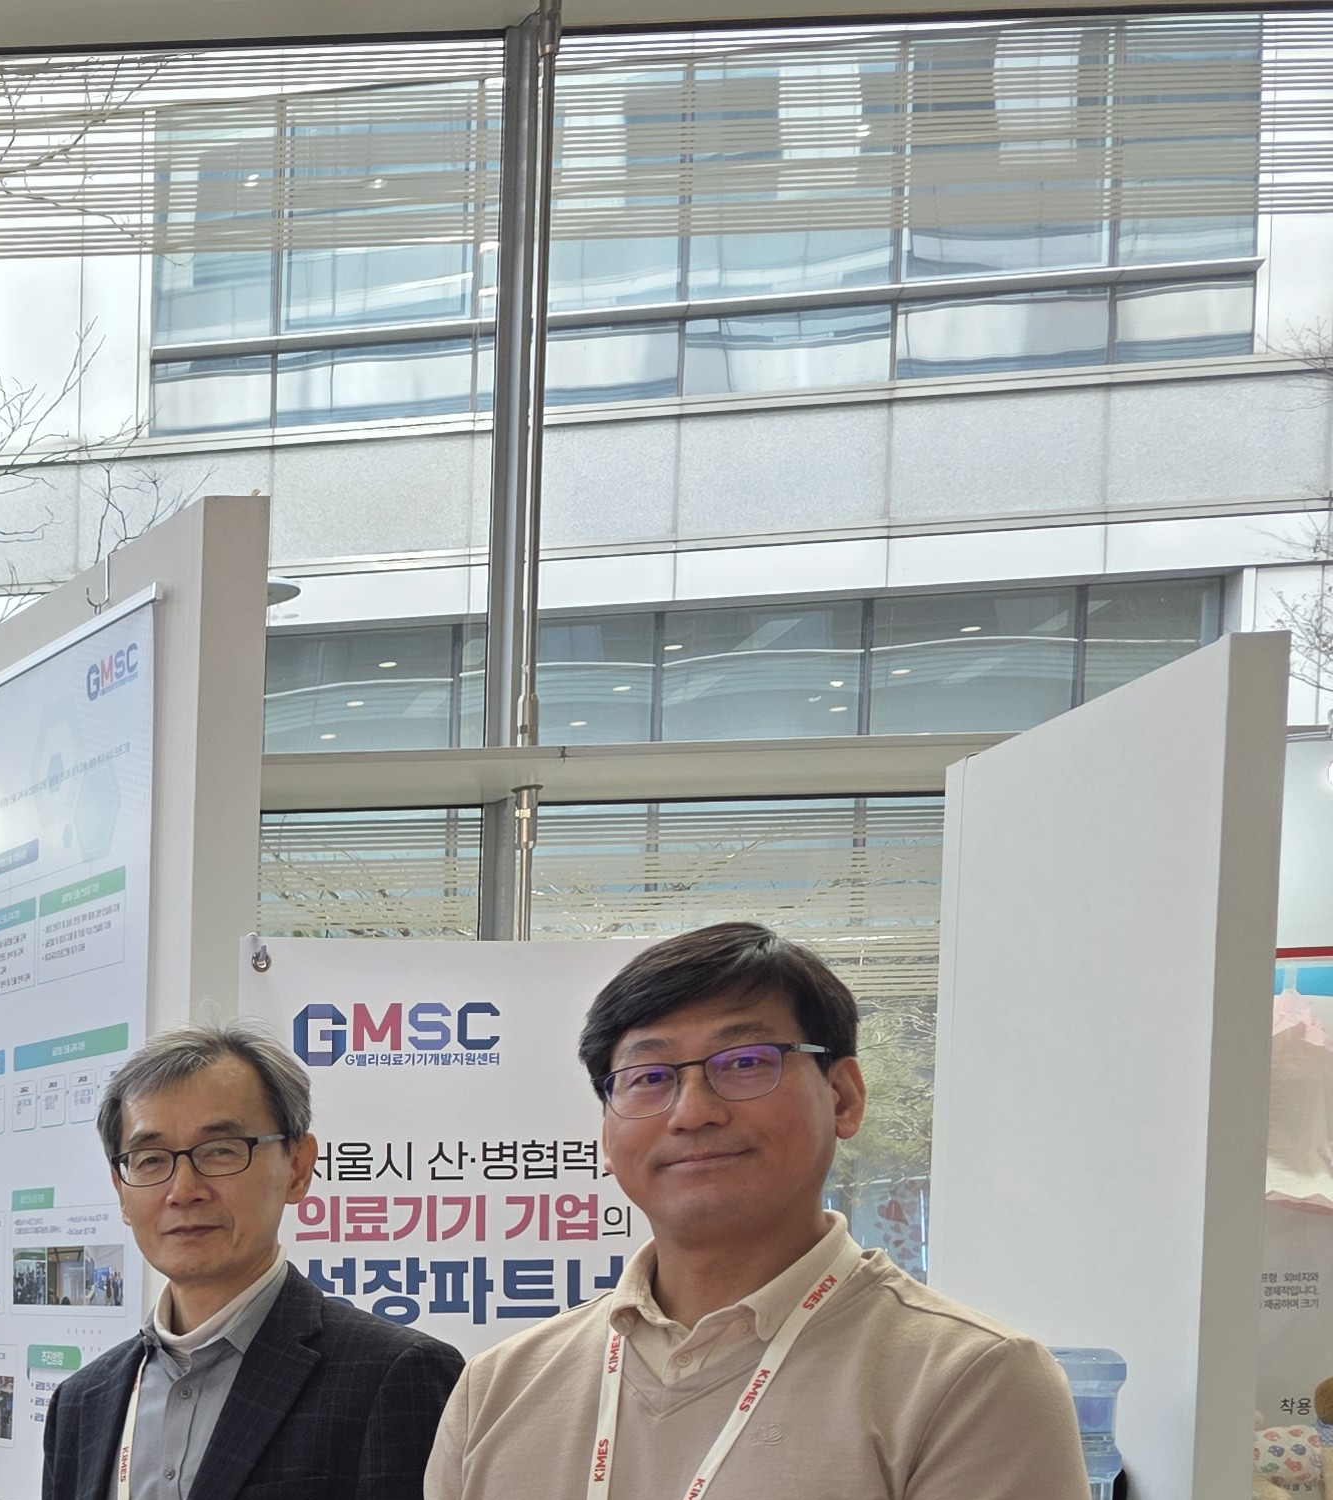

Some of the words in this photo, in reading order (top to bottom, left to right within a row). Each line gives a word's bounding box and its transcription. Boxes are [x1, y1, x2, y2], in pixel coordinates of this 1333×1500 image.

[86, 642, 139, 701] GMSC
[293, 1002, 501, 1067] GMSC
[345, 1052, 501, 1067] G밸리의료기기개발지원센터
[428, 1140, 612, 1181] 산·병협력
[295, 1194, 486, 1243] 의료기기
[504, 1193, 632, 1242] 기업의
[1280, 1398, 1312, 1415] 착용
